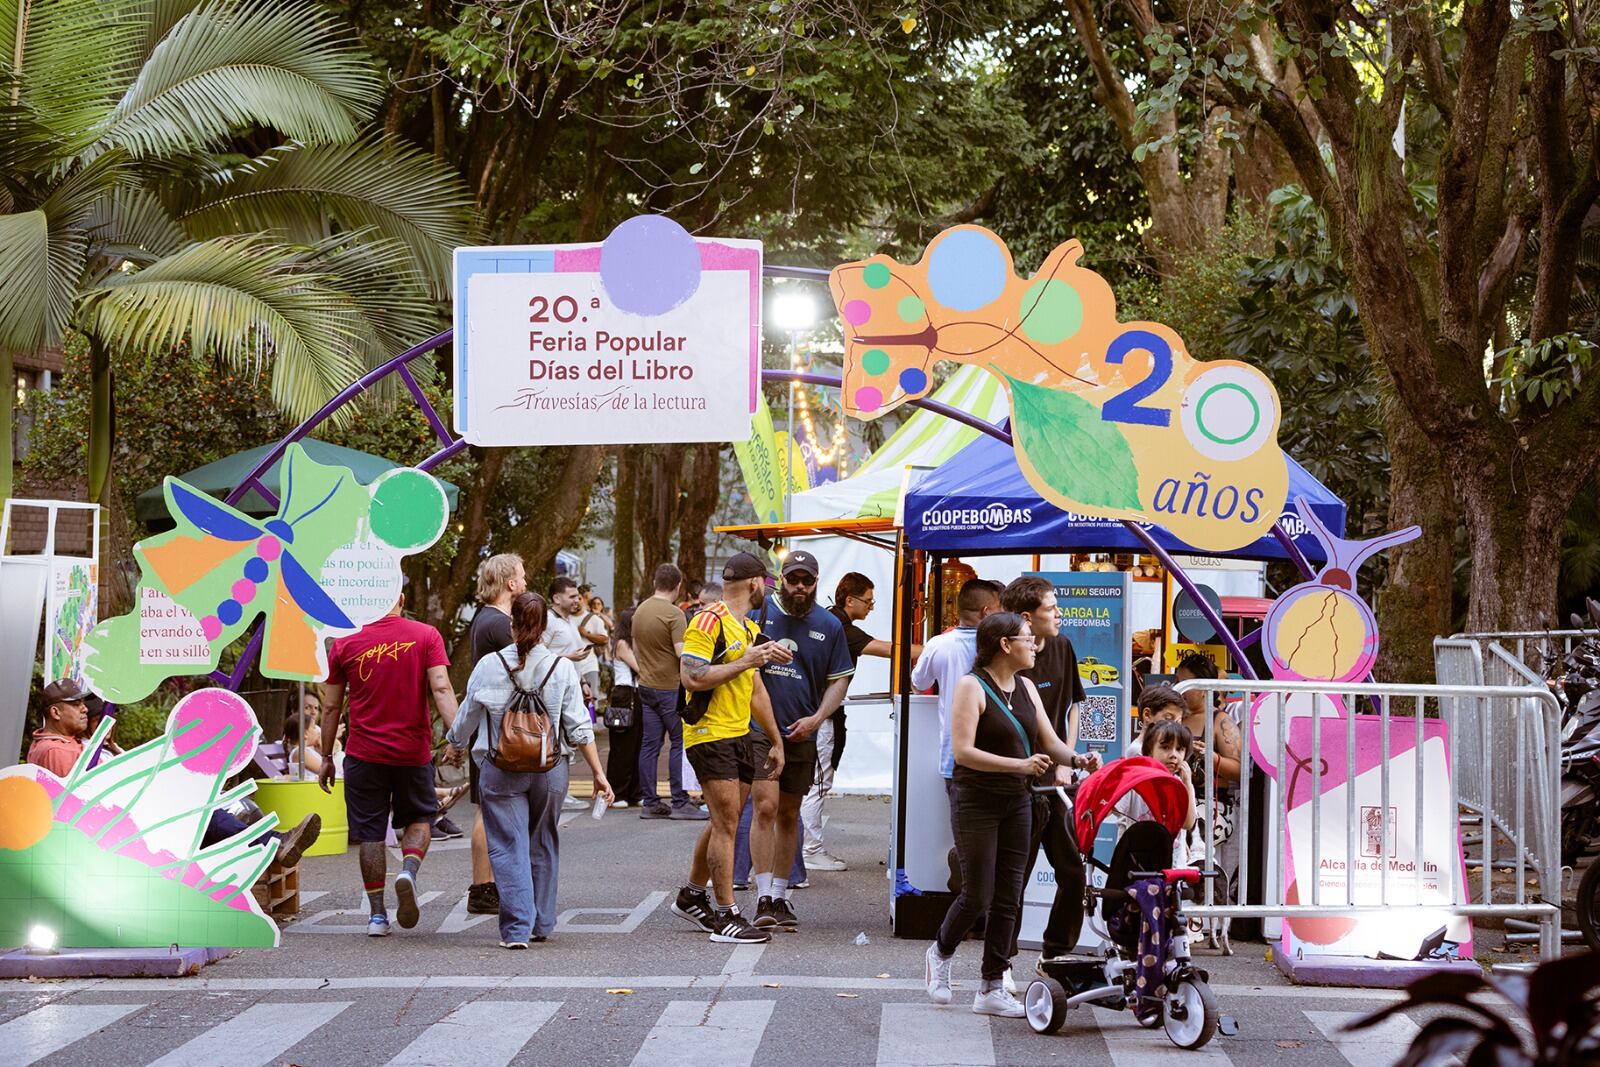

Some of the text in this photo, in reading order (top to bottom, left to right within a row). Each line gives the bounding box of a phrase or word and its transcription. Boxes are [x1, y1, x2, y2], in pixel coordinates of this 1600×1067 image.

[529, 330, 687, 356] Feria Popular
[529, 359, 694, 380] Días del Libro
[524, 392, 706, 410] Travesías de la lectura
[1152, 472, 1264, 524] años
[922, 503, 1032, 531] COOPEBOMBAS
[339, 560, 355, 569] no
[1060, 588, 1070, 596] TU
[1071, 588, 1088, 596] TAXI
[1089, 588, 1121, 597] SEGURO
[166, 605, 177, 618] el
[1096, 607, 1110, 618] LA
[147, 648, 162, 658] en
[166, 648, 180, 658] su
[182, 644, 210, 658] silló
